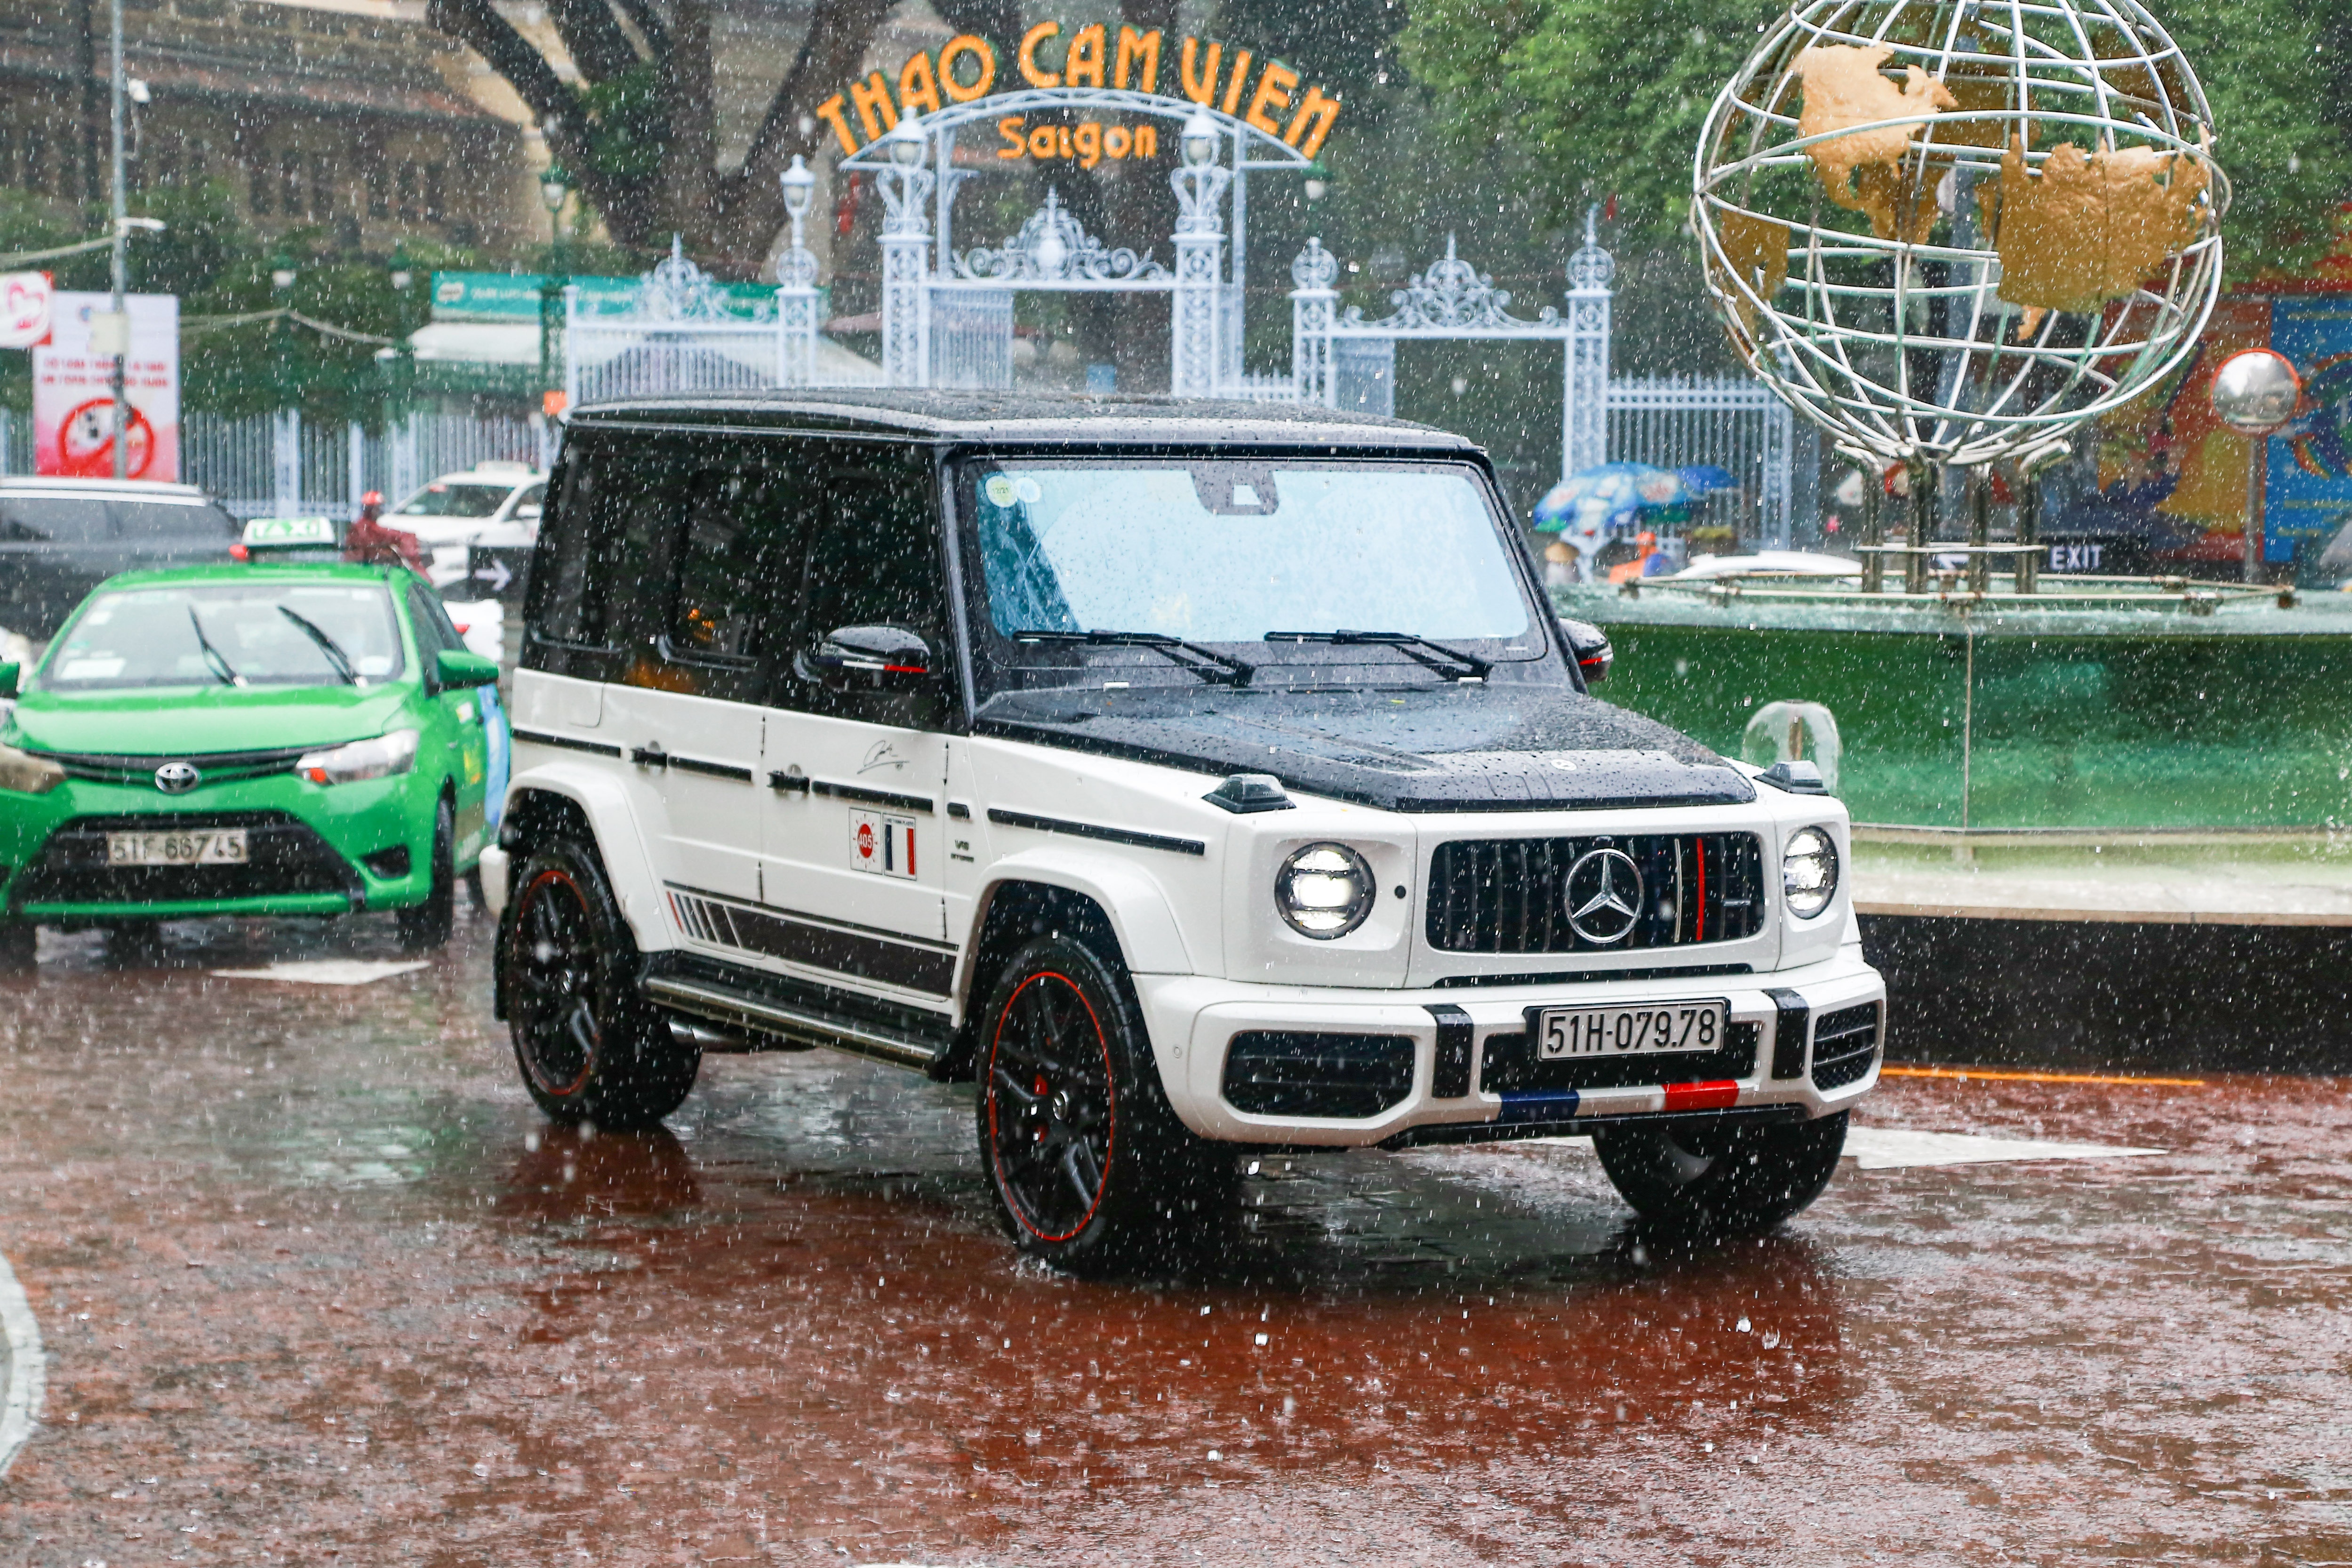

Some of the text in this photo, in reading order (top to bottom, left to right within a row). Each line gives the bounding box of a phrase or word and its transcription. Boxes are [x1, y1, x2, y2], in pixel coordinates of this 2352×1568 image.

[816, 34, 995, 156] THAO
[1019, 21, 1161, 93] CAM
[997, 117, 1157, 169] Saigon
[2050, 545, 2104, 570] EXIT
[858, 833, 872, 849] 405
[1547, 1008, 1716, 1054] 51H-079.78
